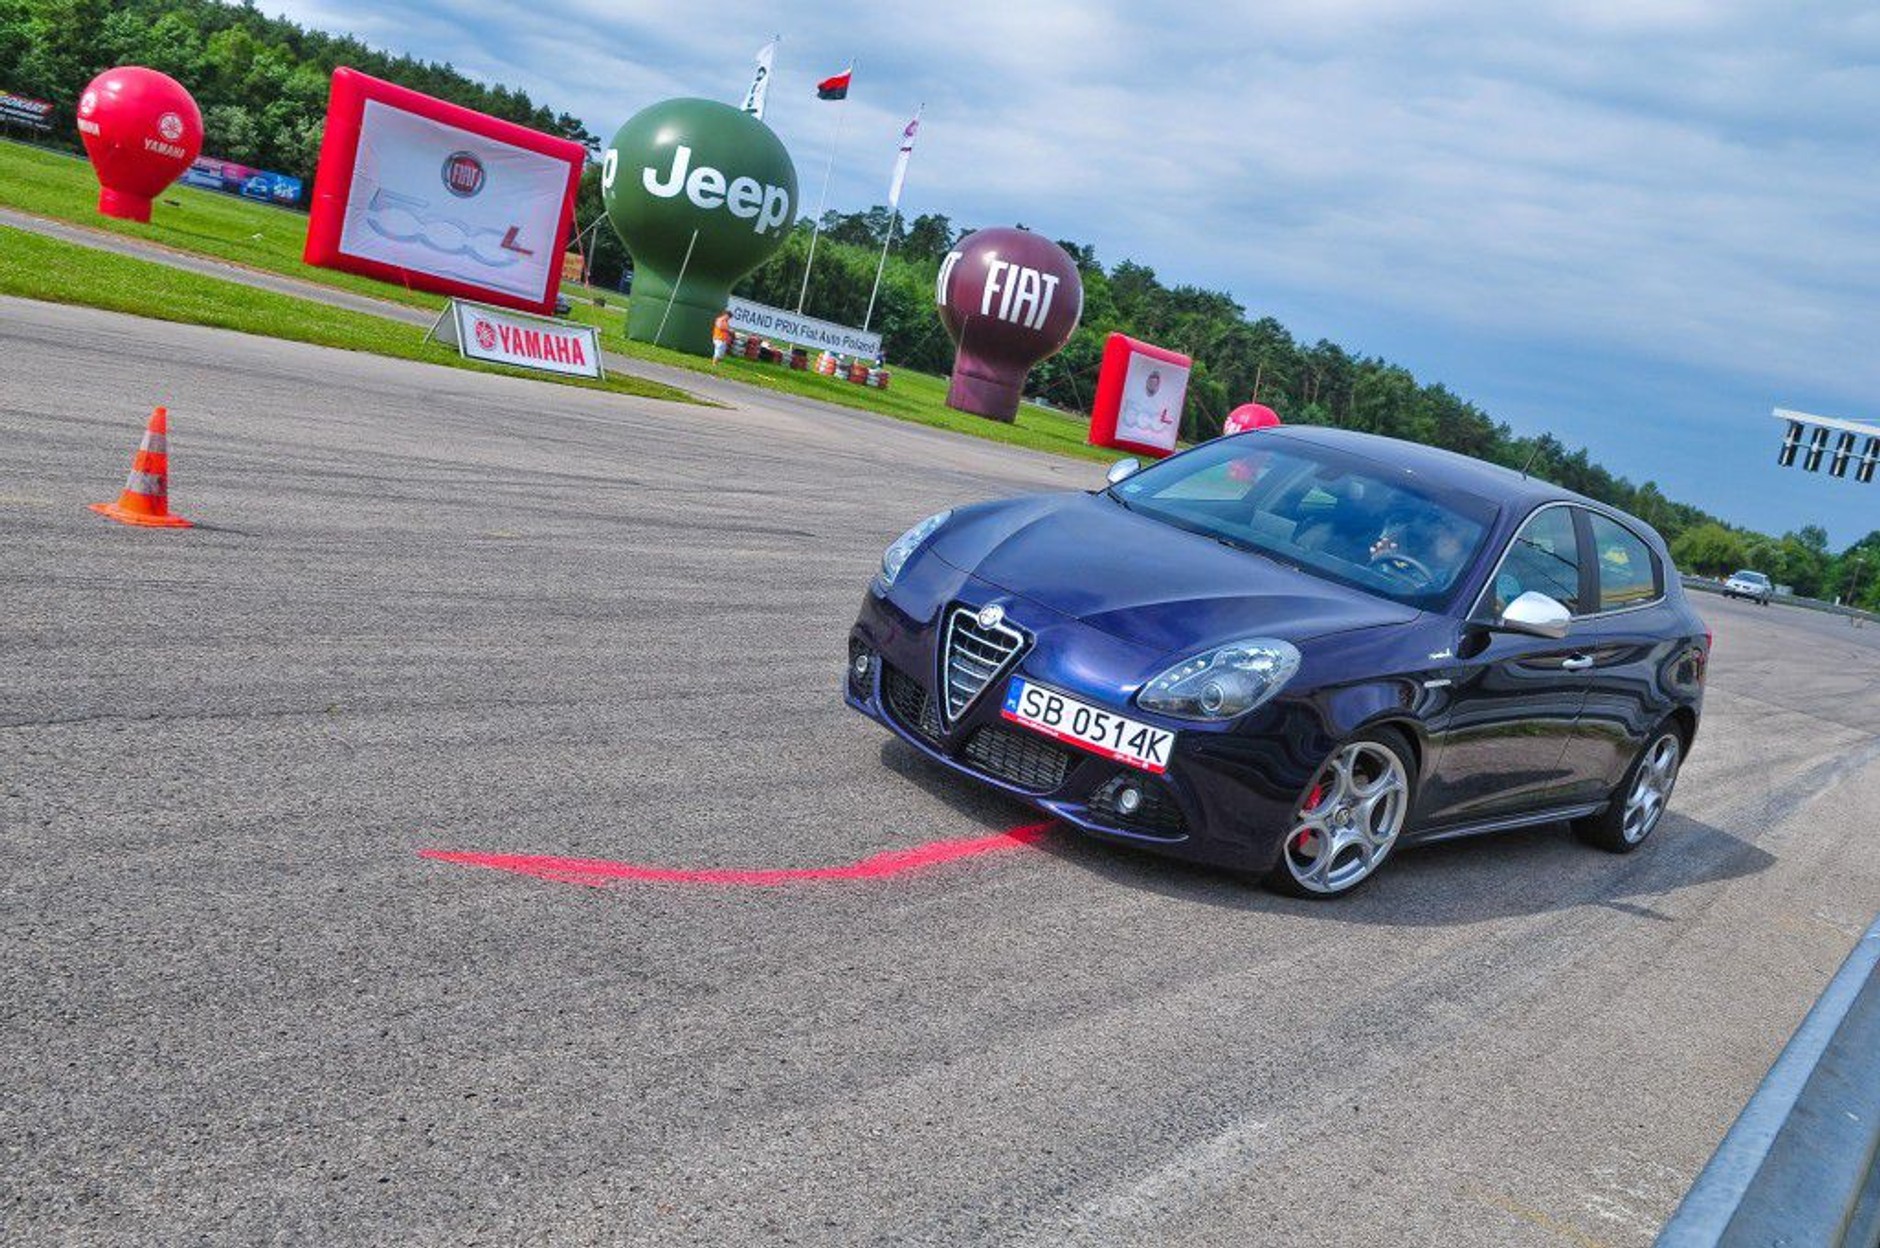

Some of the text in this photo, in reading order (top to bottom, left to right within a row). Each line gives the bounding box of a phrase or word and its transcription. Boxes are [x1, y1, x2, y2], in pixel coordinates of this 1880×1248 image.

[144, 137, 186, 159] YAMAHA
[452, 163, 478, 187] FIAT
[643, 145, 789, 235] Jeep
[981, 260, 1059, 331] FIAT
[497, 323, 585, 366] YAMAHA
[734, 307, 879, 353] GRAND PRIX Fiat Auto Poland
[1023, 689, 1064, 726] SB
[1072, 707, 1168, 763] 0514K
